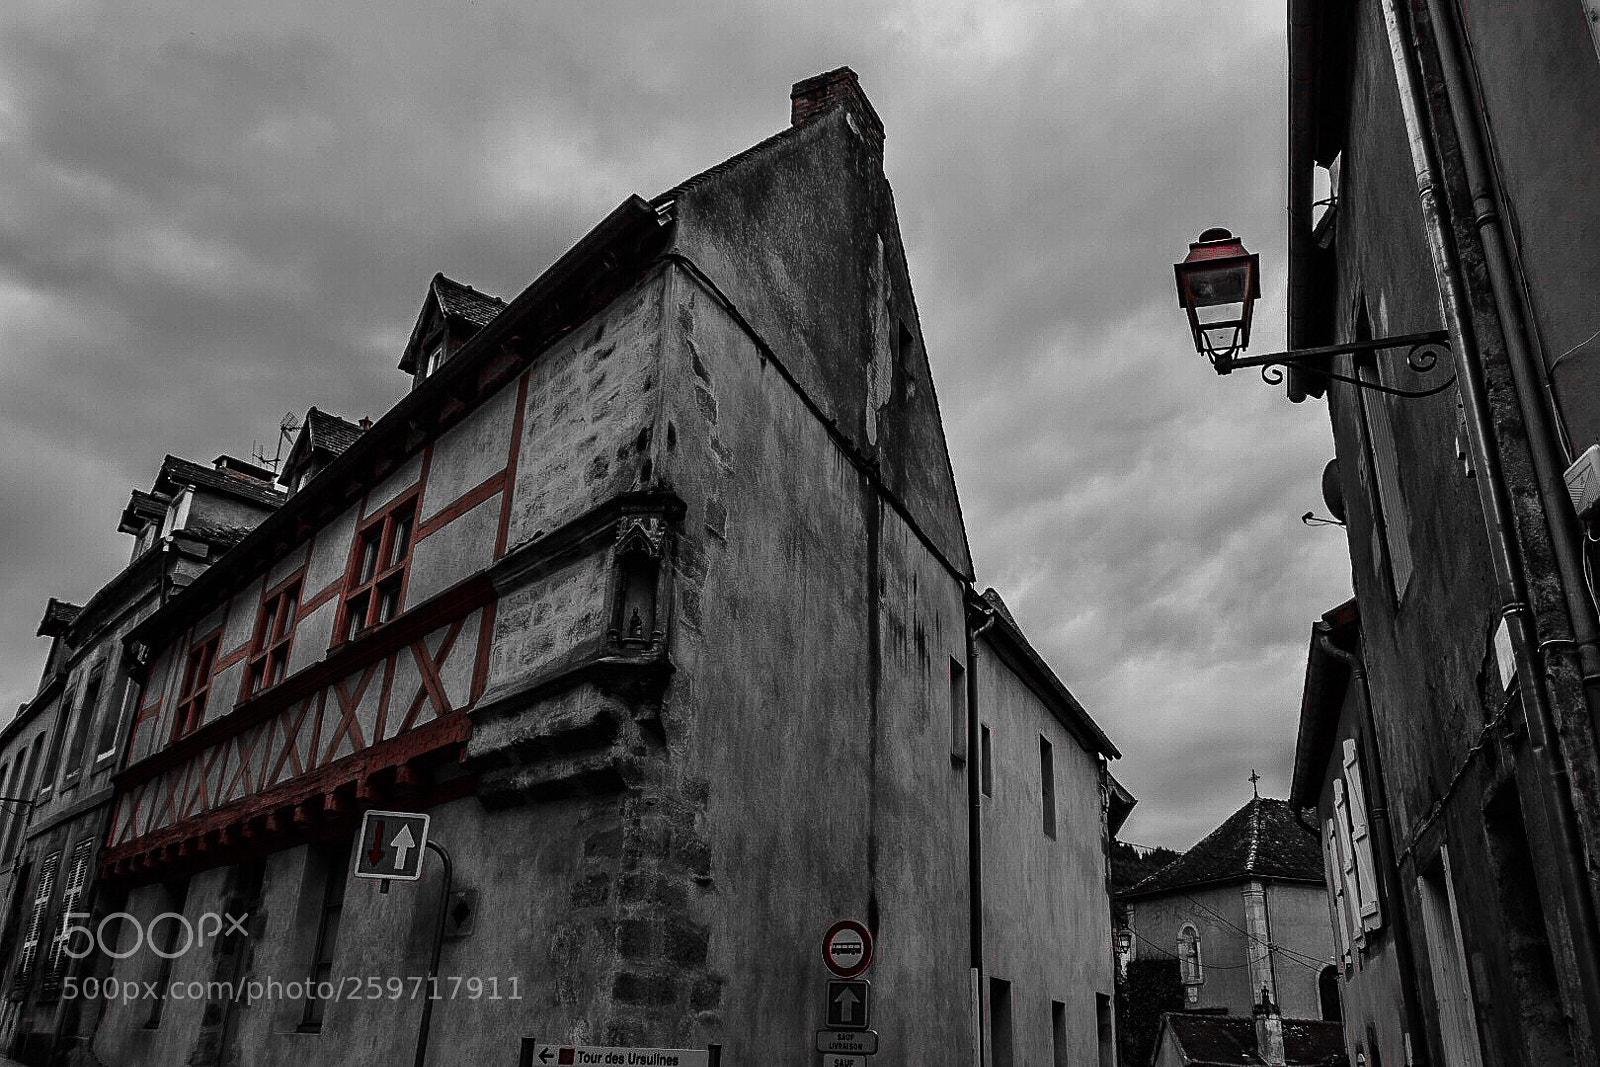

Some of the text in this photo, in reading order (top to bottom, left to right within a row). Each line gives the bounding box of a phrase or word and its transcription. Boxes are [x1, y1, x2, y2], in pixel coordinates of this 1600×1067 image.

[829, 1042, 863, 1050] LIVRAISON
[577, 1051, 679, 1066] Tour des Ursulines
[834, 1059, 854, 1067] SAUF
